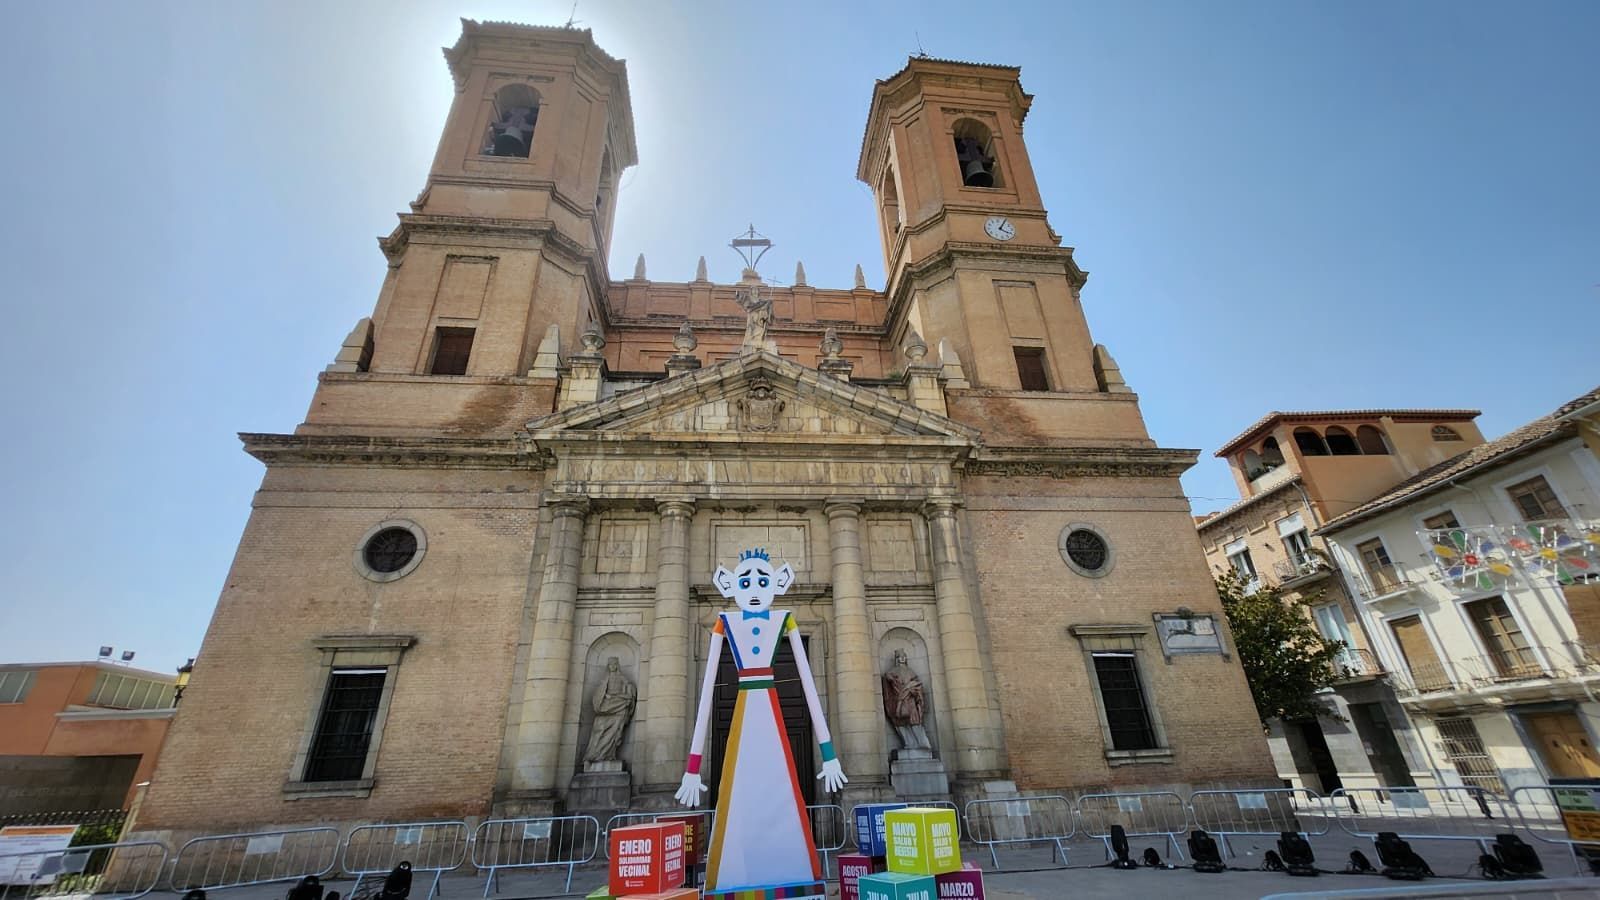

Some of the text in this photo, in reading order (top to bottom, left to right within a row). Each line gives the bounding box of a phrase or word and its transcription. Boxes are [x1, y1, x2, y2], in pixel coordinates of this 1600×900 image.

[892, 822, 917, 837] MAYO
[931, 822, 951, 837] MAYO
[619, 839, 651, 855] ENERO
[665, 834, 682, 851] ENERO
[618, 864, 651, 878] VECINAL
[842, 865, 868, 878] AGOSTO
[866, 890, 889, 900] JULIO
[906, 890, 929, 900] JULIO
[939, 882, 975, 897] MARZO
